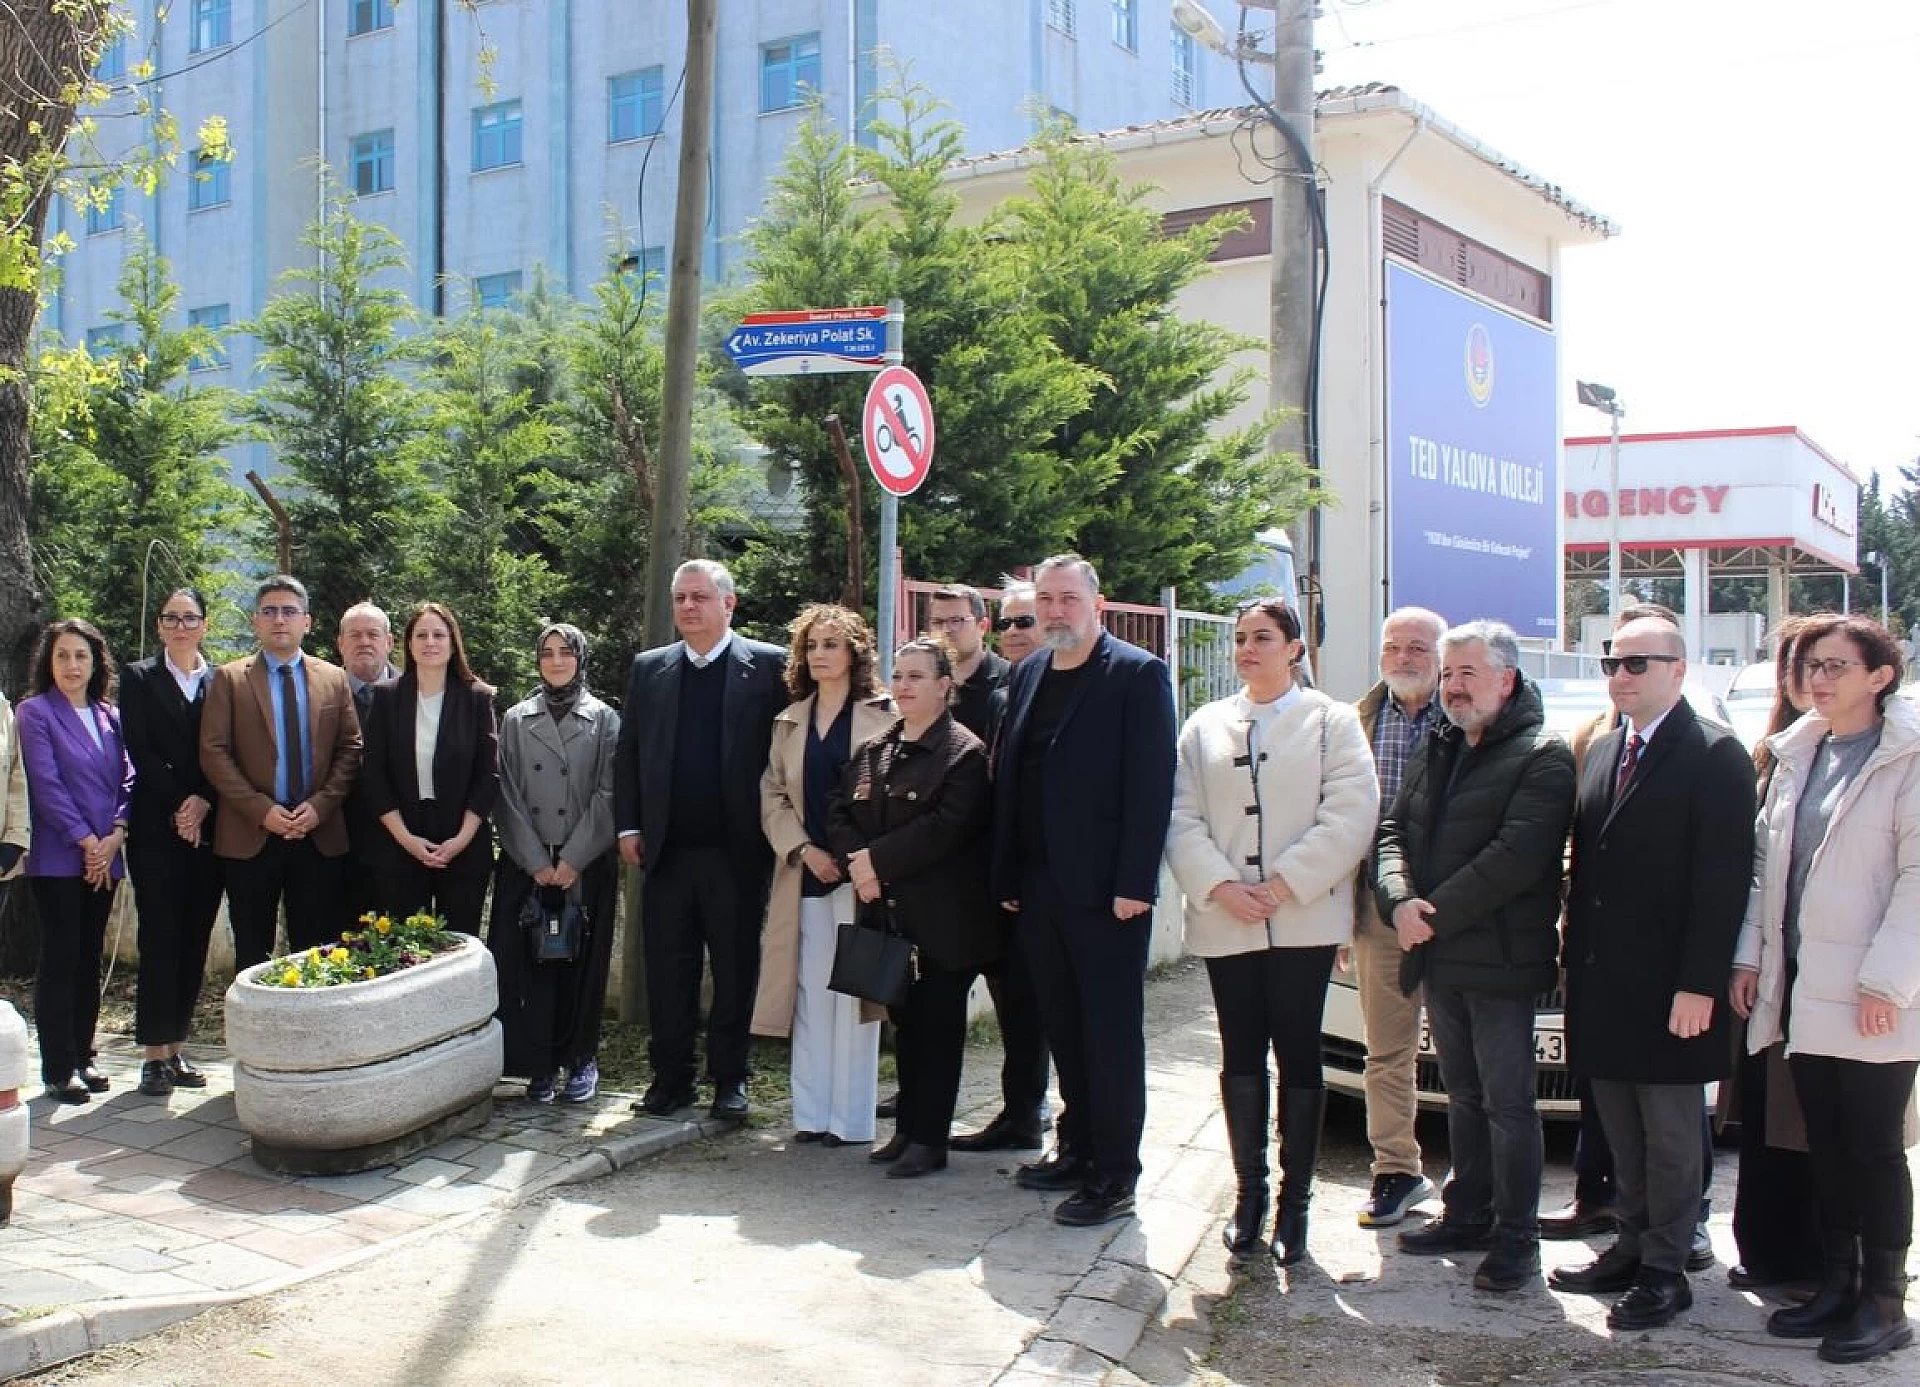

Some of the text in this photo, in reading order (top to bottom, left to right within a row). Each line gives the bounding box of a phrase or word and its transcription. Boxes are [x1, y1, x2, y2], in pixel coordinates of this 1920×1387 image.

[742, 325, 876, 347] Av. Zekeriya Polat Sk.
[1409, 435, 1544, 505] TED YALOVA KOLEJİ
